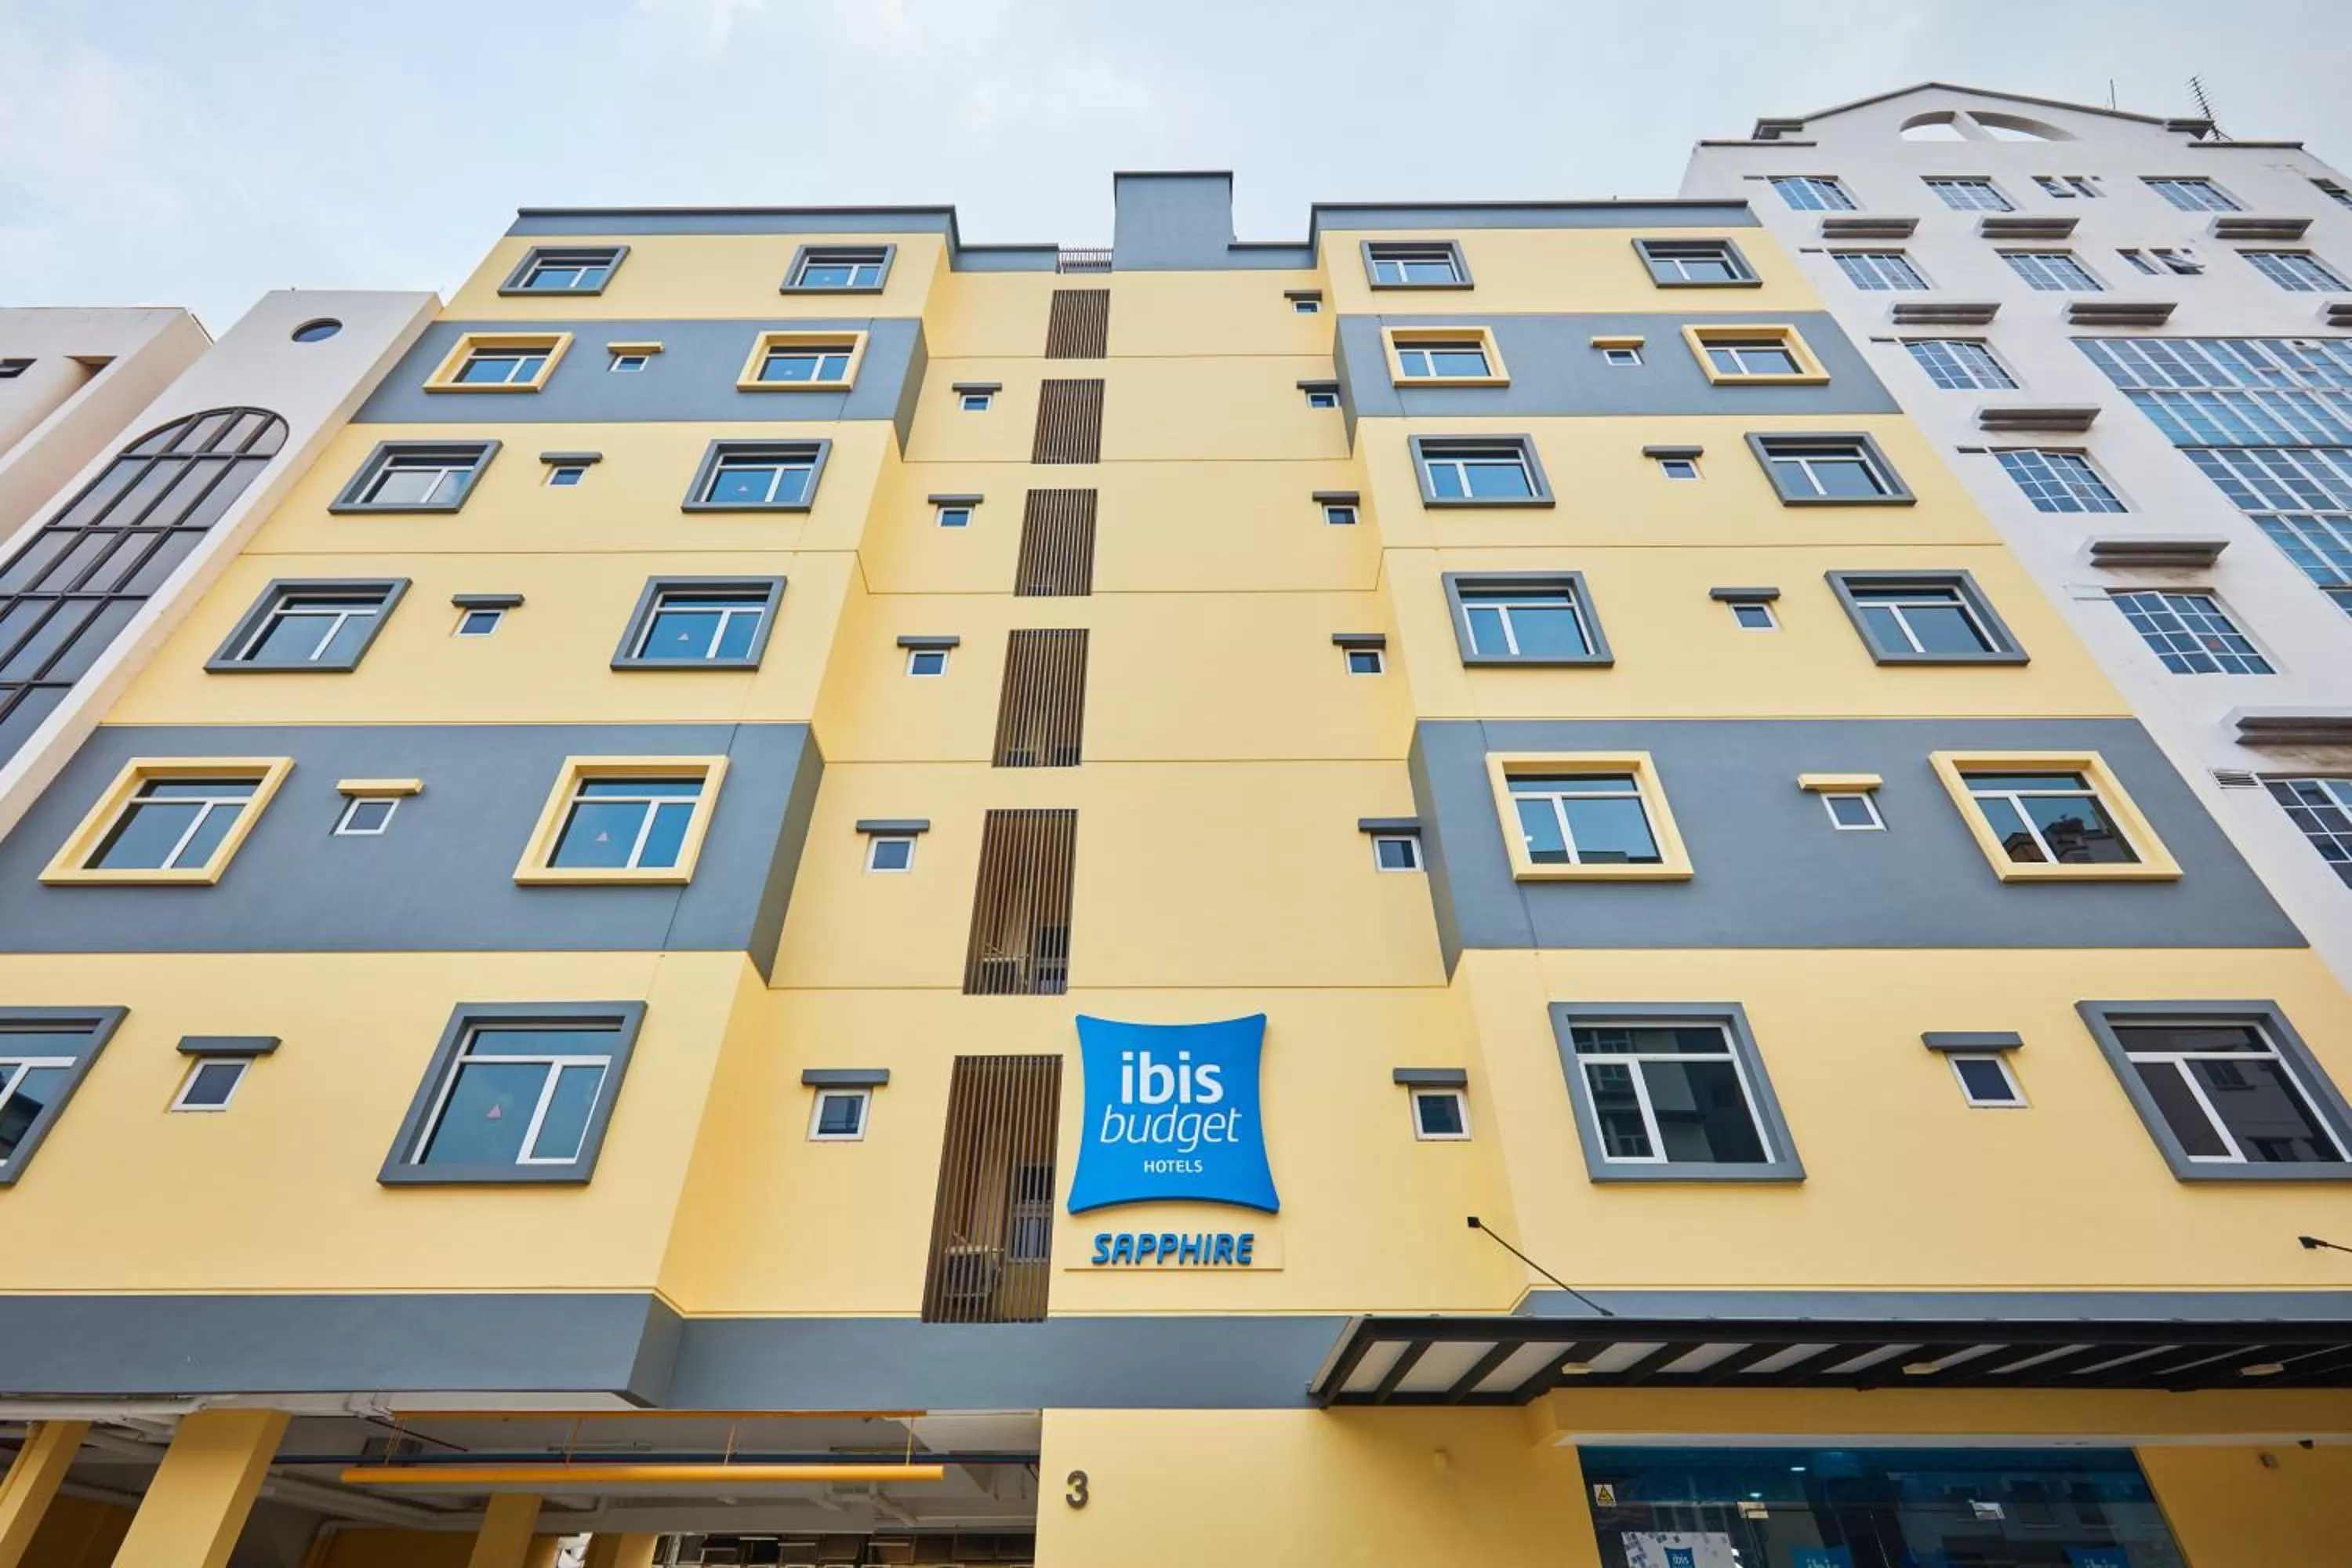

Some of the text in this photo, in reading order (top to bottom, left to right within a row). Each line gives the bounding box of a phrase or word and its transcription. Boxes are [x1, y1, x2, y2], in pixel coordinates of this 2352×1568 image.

[1121, 1051, 1225, 1105] ibis
[1100, 1103, 1243, 1153] budget
[1143, 1160, 1203, 1174] HOTELS
[1091, 1232, 1255, 1265] SAPPHIRE
[1065, 1470, 1089, 1510] 3
